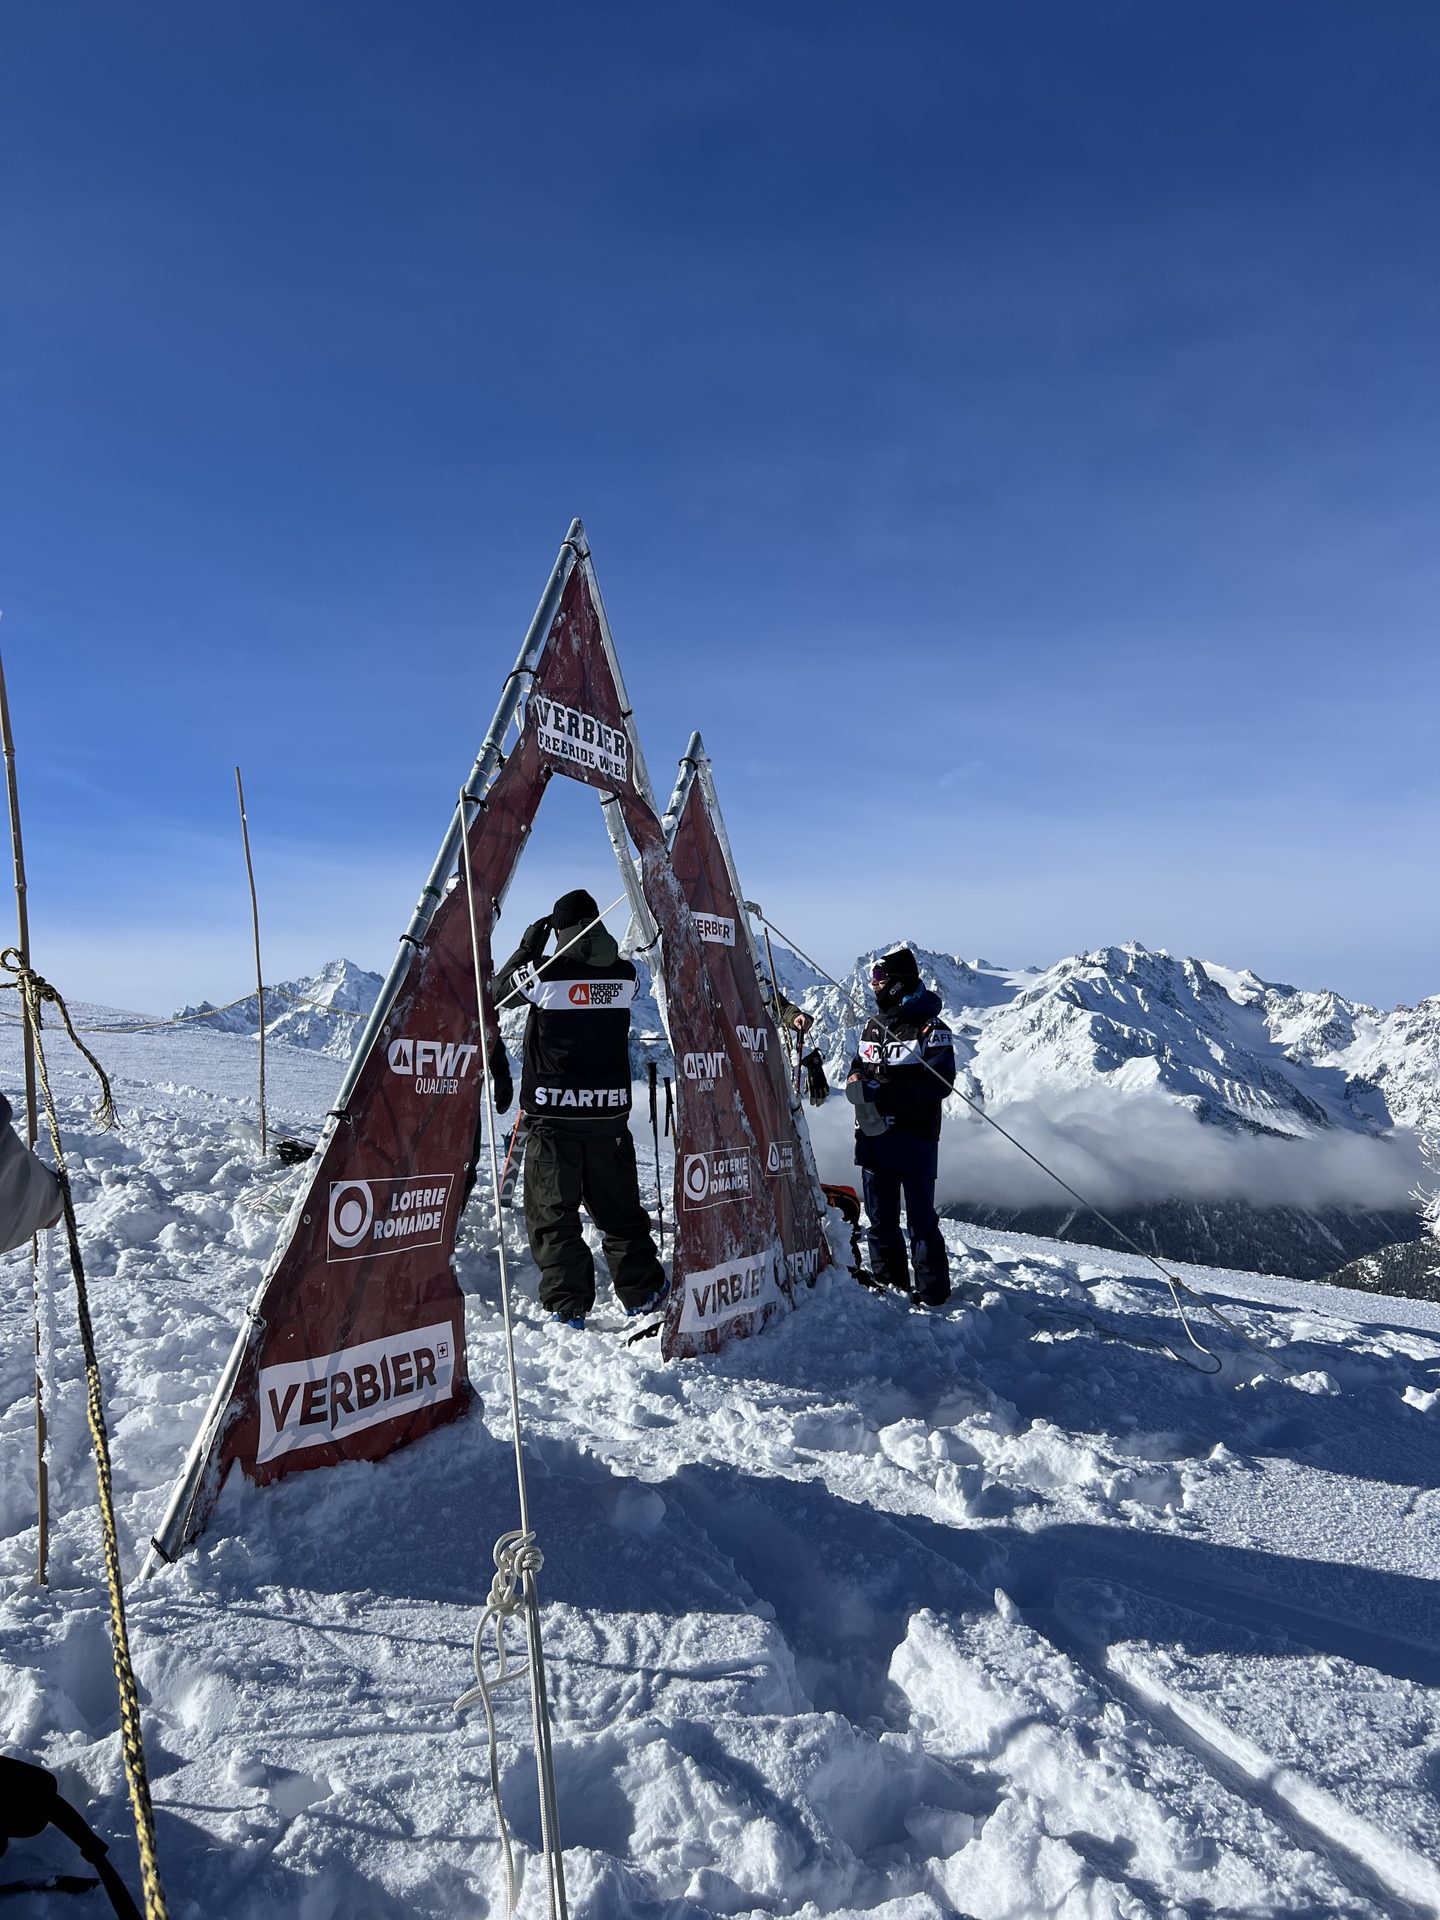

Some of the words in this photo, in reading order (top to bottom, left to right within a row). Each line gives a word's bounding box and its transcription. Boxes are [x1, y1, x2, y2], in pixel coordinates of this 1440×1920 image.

[536, 699, 626, 759] VERBIER
[538, 730, 595, 765] FREERIDE
[694, 919, 730, 939] ERBIR
[590, 983, 623, 991] FREERIDE
[590, 990, 619, 998] WORLD
[590, 997, 612, 1005] TOUR
[416, 1040, 478, 1077] FWT
[695, 1053, 725, 1079] FWT
[415, 1078, 459, 1095] QUALIFIER
[713, 1156, 748, 1175] LOTERIE
[391, 1187, 447, 1213] LOTERIE
[373, 1212, 442, 1240] ROMANDE
[268, 1347, 437, 1433] VERBIER
